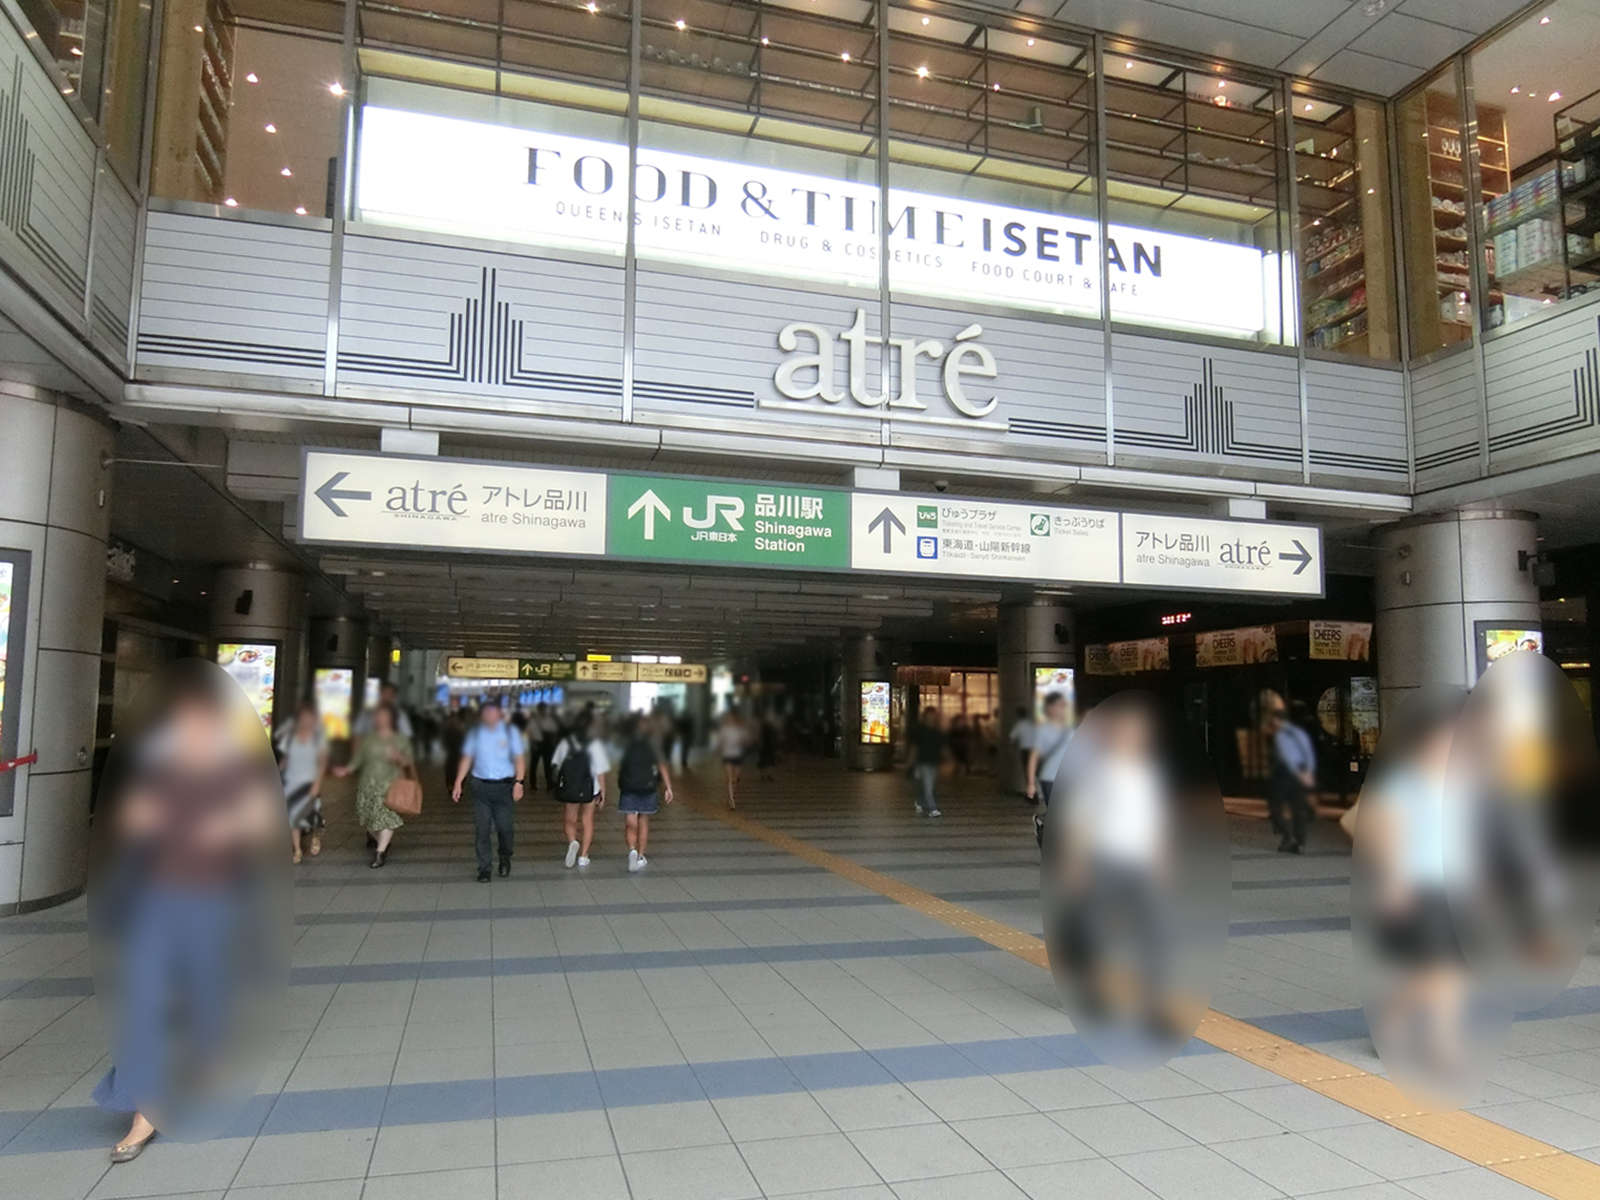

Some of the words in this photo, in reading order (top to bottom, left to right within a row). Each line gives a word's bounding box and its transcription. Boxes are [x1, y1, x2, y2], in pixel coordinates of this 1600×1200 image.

[521, 146, 718, 210] FOOD
[740, 180, 781, 221] &
[791, 187, 965, 248] TIME
[982, 217, 1162, 278] ISETAN
[654, 215, 722, 237] ISETAN
[761, 230, 809, 250] DRUG
[822, 239, 832, 252] &
[845, 242, 943, 269] COSETICS
[972, 261, 1014, 280] FOOD
[1022, 269, 1074, 288] COURT
[1082, 278, 1093, 291] &
[1110, 281, 1138, 297] AFE
[773, 308, 998, 418] atré
[385, 480, 468, 515] atré
[482, 486, 588, 513] アトレ品川
[754, 493, 823, 520] 品川駅
[481, 513, 508, 524] atre
[512, 512, 587, 529] Shinagawa
[682, 495, 745, 531] JR
[942, 508, 997, 521] びゅうプラザ
[1054, 516, 1105, 529] きっぷうりば
[691, 531, 738, 543] JR東日本
[754, 520, 832, 538] Shinagawa
[754, 537, 805, 552] Station
[1136, 531, 1210, 553] アトレ品川
[1219, 538, 1272, 566] atré
[1136, 554, 1155, 564] atre
[1158, 553, 1210, 569] Shinagawa
[1212, 637, 1236, 650] CHEERS
[1314, 629, 1342, 641] CHEERS
